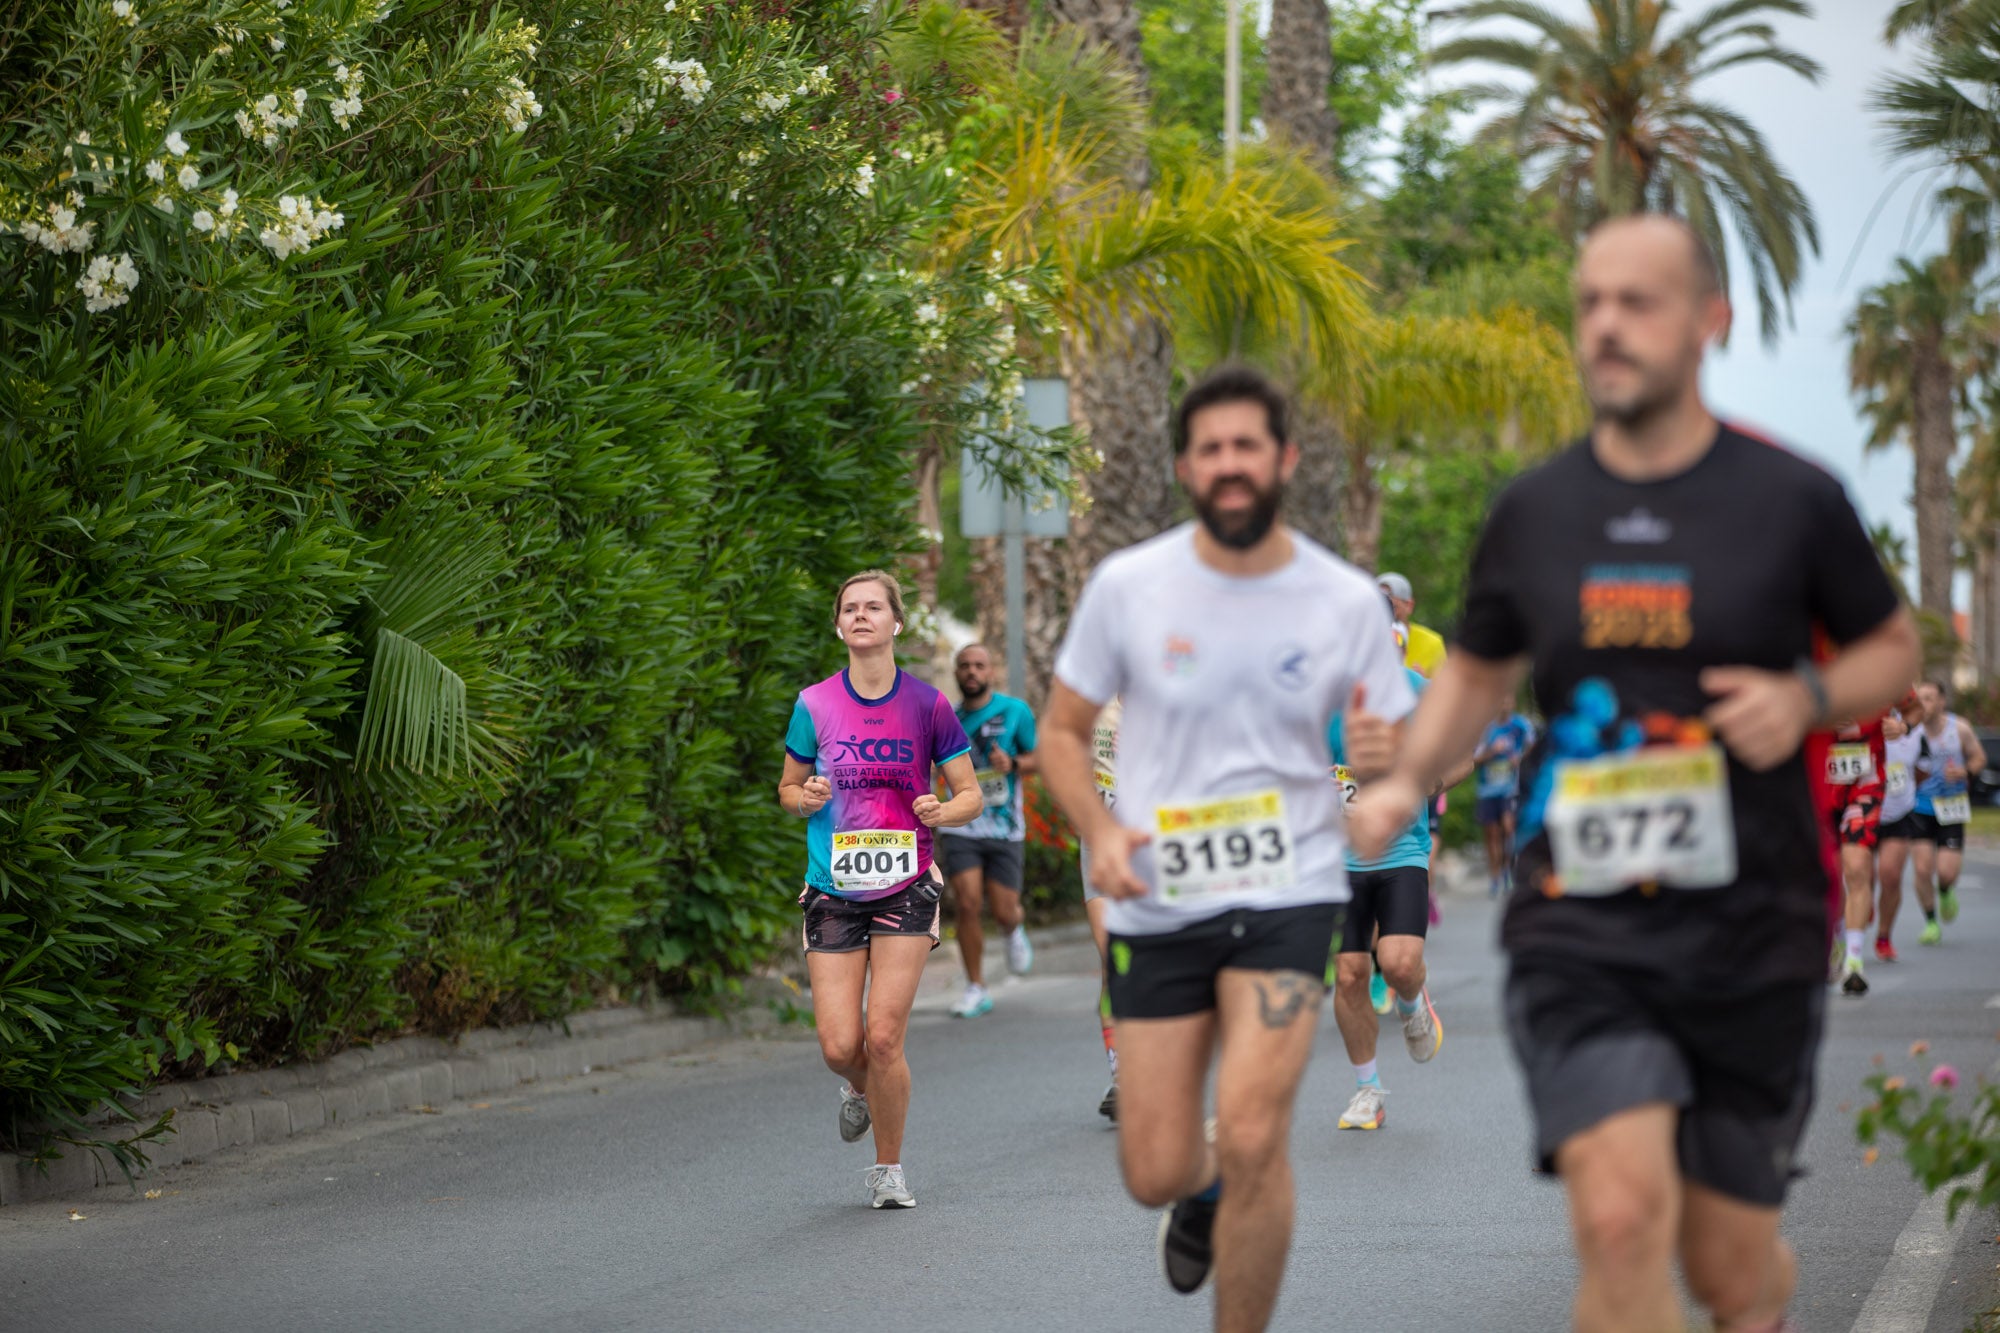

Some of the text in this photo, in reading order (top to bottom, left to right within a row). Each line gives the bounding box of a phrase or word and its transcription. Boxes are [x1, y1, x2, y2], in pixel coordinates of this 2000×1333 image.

[859, 738, 914, 763] cas
[834, 767, 915, 779] CLUB ATLETISMO
[1576, 798, 1702, 862] 672
[833, 851, 910, 875] 4001
[1161, 825, 1286, 877] 3193
